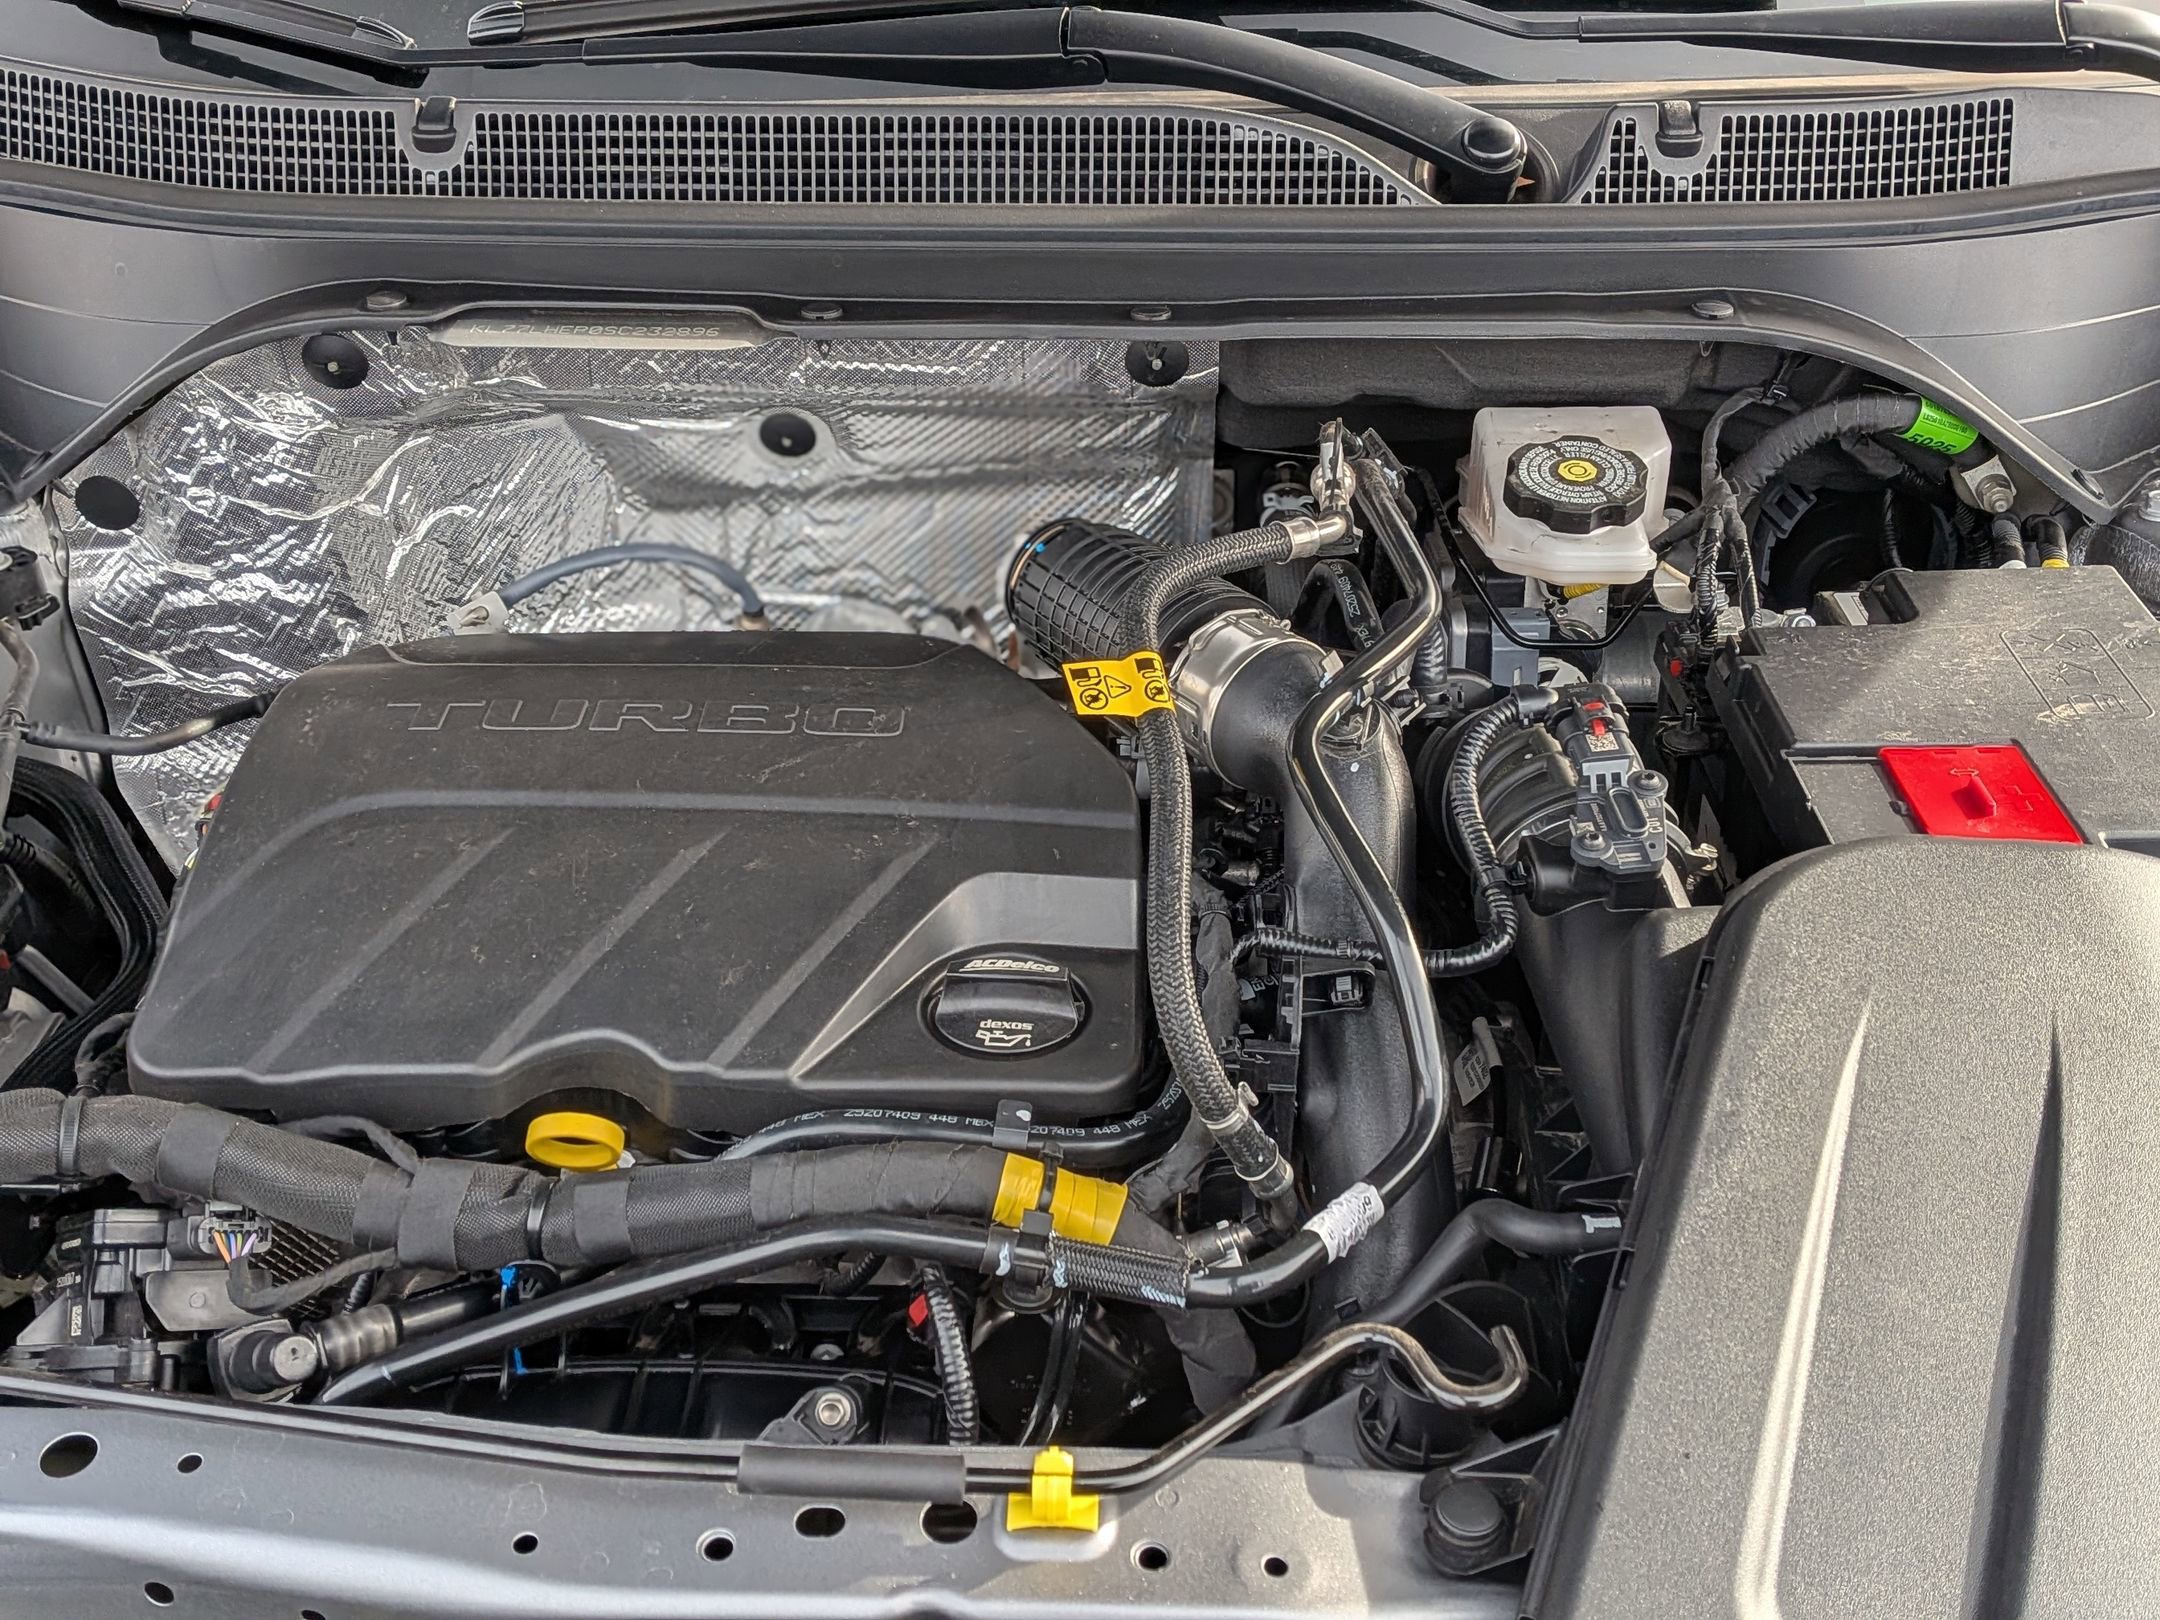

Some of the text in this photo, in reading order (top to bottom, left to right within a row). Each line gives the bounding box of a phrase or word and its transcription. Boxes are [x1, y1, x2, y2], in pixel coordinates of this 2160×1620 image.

[387, 698, 907, 737] TURBO
[964, 958, 1061, 974] ACDelco
[979, 1019, 1035, 1031] dexos
[843, 1108, 921, 1121] 25207409
[928, 1113, 958, 1124] 448
[1093, 1124, 1122, 1135] 448
